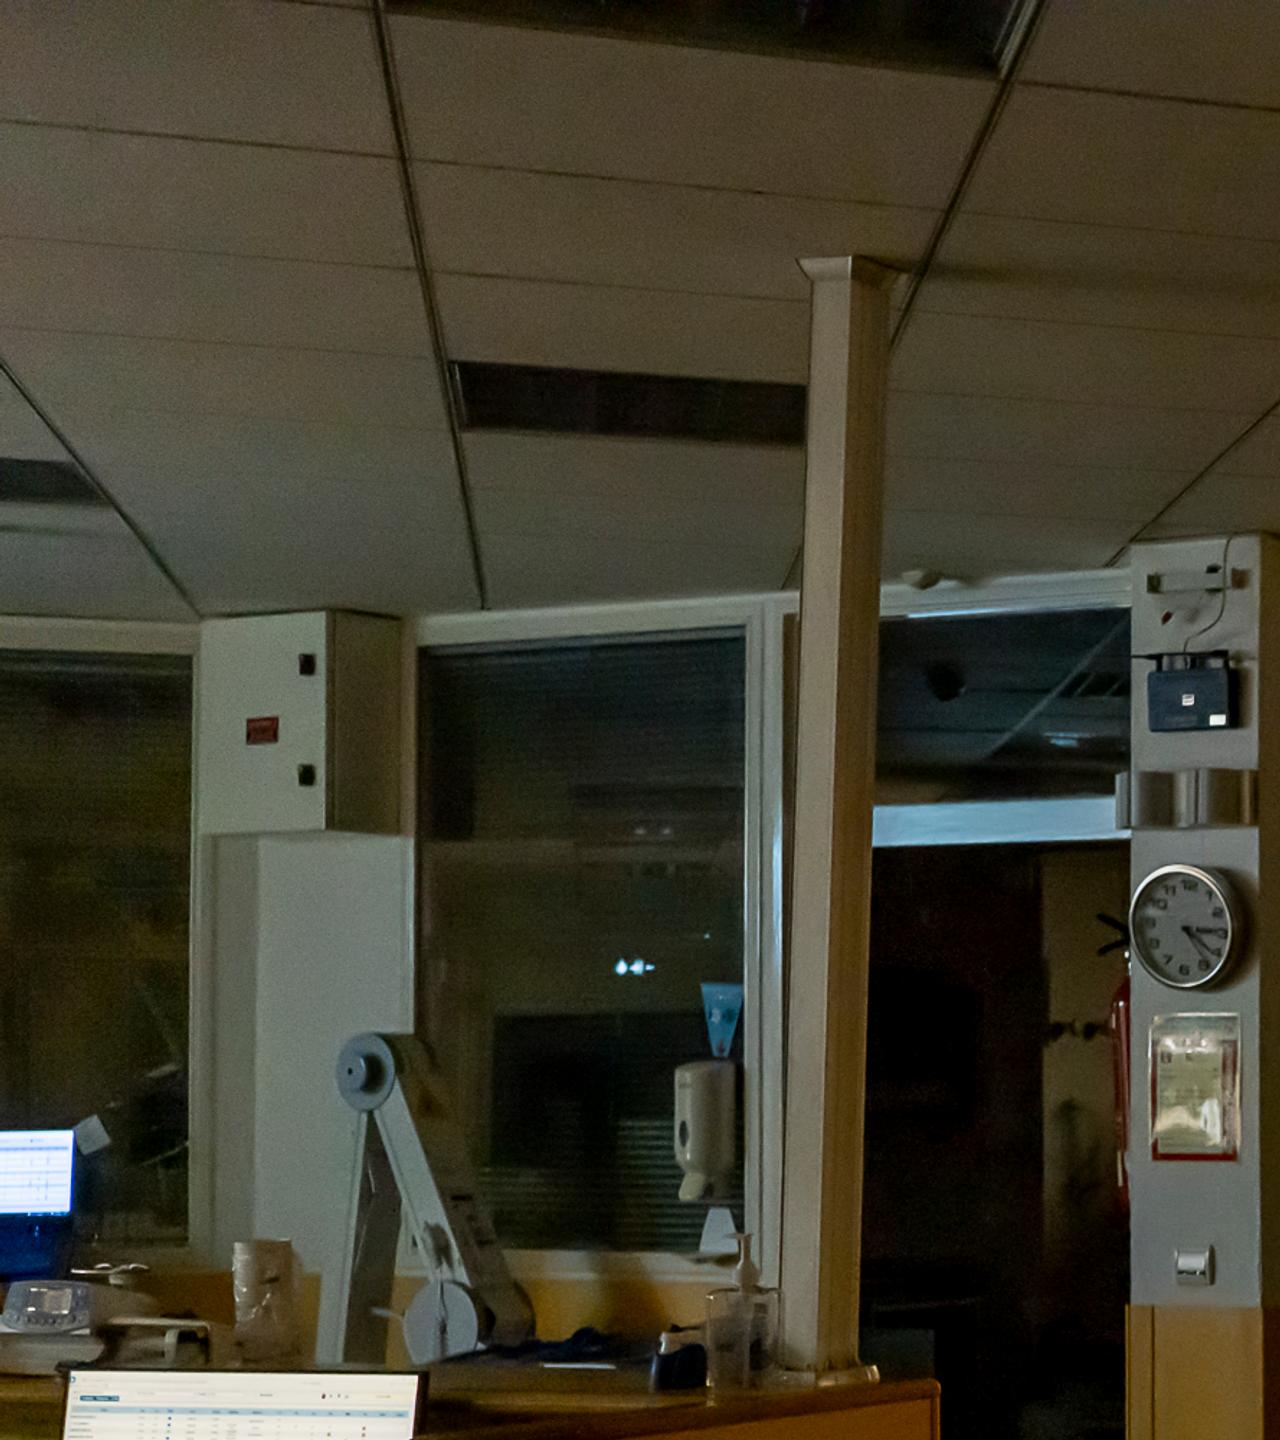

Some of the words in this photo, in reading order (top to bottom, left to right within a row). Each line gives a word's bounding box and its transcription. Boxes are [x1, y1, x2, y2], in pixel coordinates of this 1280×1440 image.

[1163, 883, 1177, 897] 11
[1181, 878, 1199, 892] 12
[1206, 889, 1213, 902] 1
[1151, 898, 1168, 911] 10
[1212, 906, 1224, 918] 2
[1144, 917, 1157, 929] 9
[1217, 927, 1228, 940] 3
[1150, 937, 1161, 950] 8
[1162, 953, 1173, 965] 7
[1211, 947, 1222, 958] 4
[1179, 963, 1190, 976] 6
[1198, 958, 1211, 972] 5
